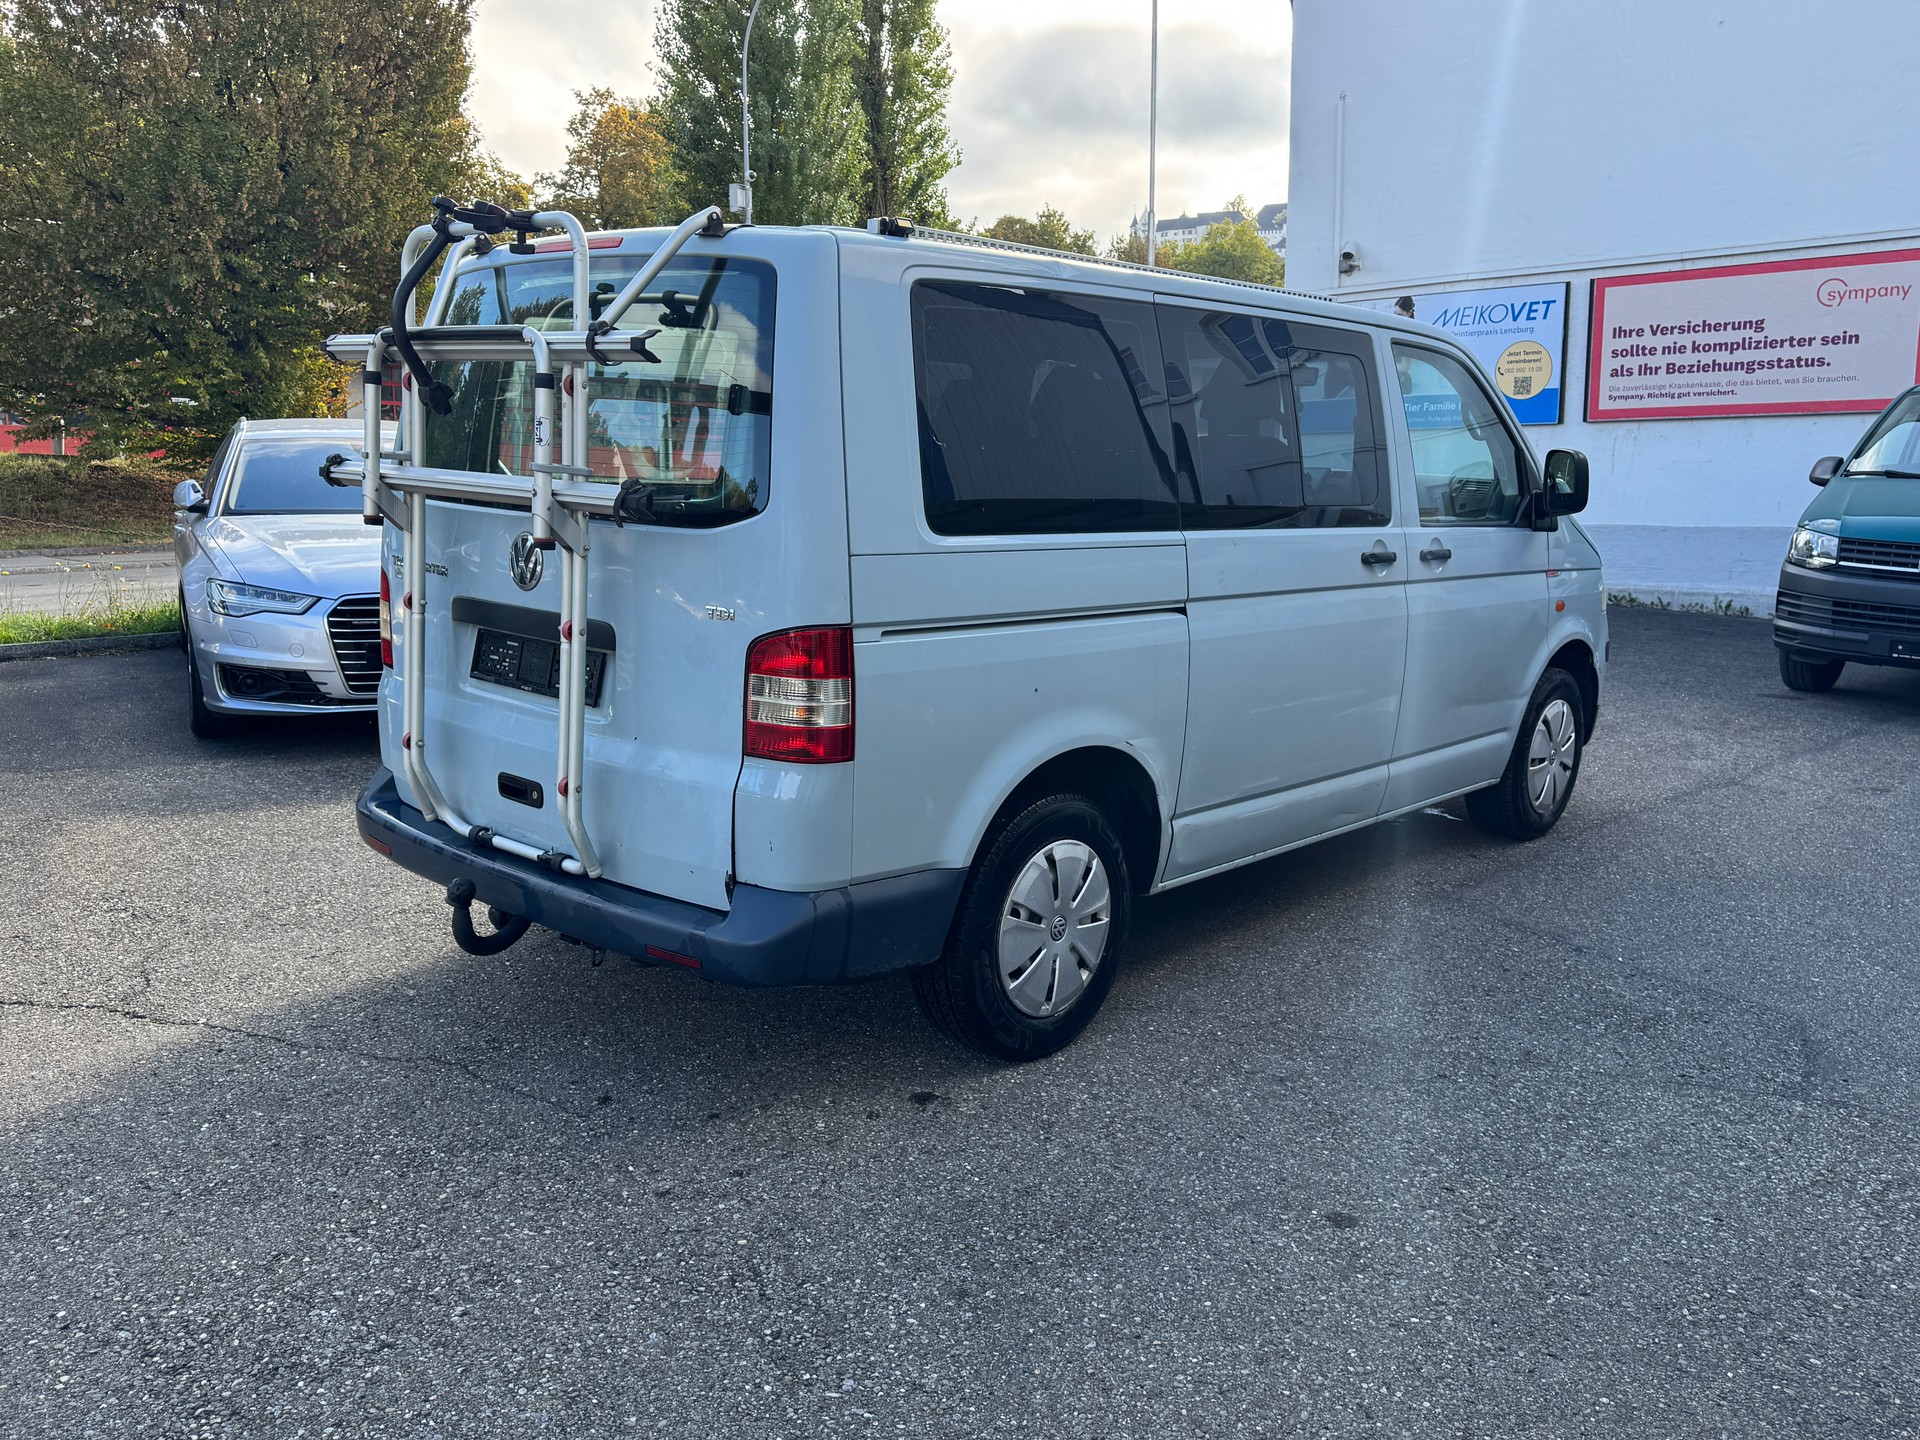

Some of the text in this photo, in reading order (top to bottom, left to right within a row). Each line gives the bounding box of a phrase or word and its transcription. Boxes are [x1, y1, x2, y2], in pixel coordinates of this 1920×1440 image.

[1827, 284, 1912, 307] sympany
[1432, 299, 1556, 327] MEIKOVET
[1451, 326, 1534, 338] leintierpraxis Lenzburg
[1612, 318, 1765, 339] Ihre Versicherung
[1611, 330, 1860, 359] sollte nie komplizierter sein
[1609, 355, 1831, 378] als Ihr Beziehungsstatus.
[1622, 383, 1667, 392] zuverlässige
[1668, 380, 1724, 390] Krankenkasse,
[1725, 379, 1738, 387] die
[1739, 378, 1754, 387] das
[1755, 377, 1782, 386] bietet,
[1817, 374, 1859, 383] brauchen.
[1608, 389, 1738, 402] Sympany. Richtig gut versichert.
[1423, 401, 1456, 411] Familie
[705, 605, 736, 622] TDI
